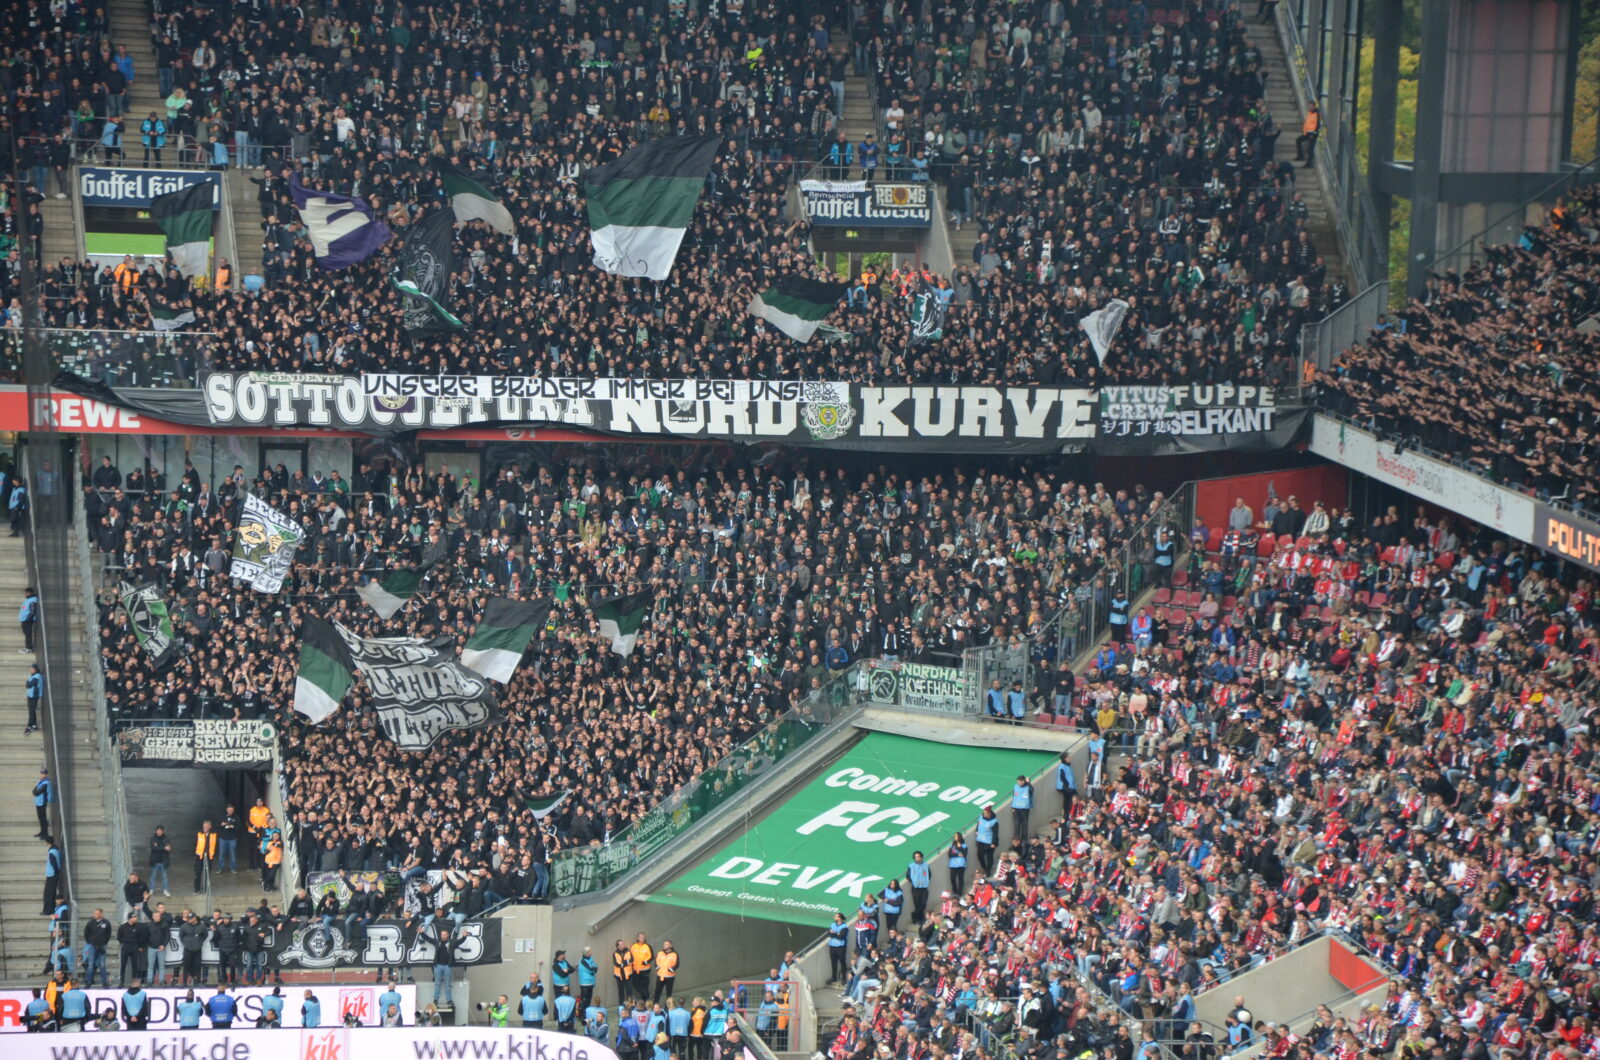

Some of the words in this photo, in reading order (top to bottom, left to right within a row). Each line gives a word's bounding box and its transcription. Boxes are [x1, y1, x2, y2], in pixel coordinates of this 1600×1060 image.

[81, 171, 145, 199] Gaffel
[249, 371, 345, 386] ASCENDENTE
[364, 375, 478, 397] UNSERE
[608, 379, 685, 400] IMMER
[697, 379, 735, 400] BEI
[751, 380, 804, 402] UNS!
[1103, 385, 1170, 403] VITUS
[1173, 384, 1277, 406] FUPPE
[34, 397, 140, 429] REWE
[860, 387, 1099, 438] KURVE
[1107, 403, 1168, 420] CREW
[1170, 407, 1277, 435] SELFKANT
[193, 719, 264, 735] BEGLEIT
[376, 700, 489, 750] ULTRAS
[142, 747, 194, 760] EINIGES
[144, 737, 191, 748] GEHT
[194, 734, 262, 749] SERVICE
[824, 766, 940, 798] Come
[795, 800, 951, 847] FC!
[708, 856, 884, 898] DEVK
[687, 884, 733, 898] Gesagt.
[737, 891, 777, 904] Getan.
[779, 897, 840, 914] Geholfen.
[341, 992, 368, 1018] kik
[51, 1036, 250, 1060] www.kik.de
[305, 1032, 344, 1060] kik
[412, 1034, 589, 1060] www.kik.de
